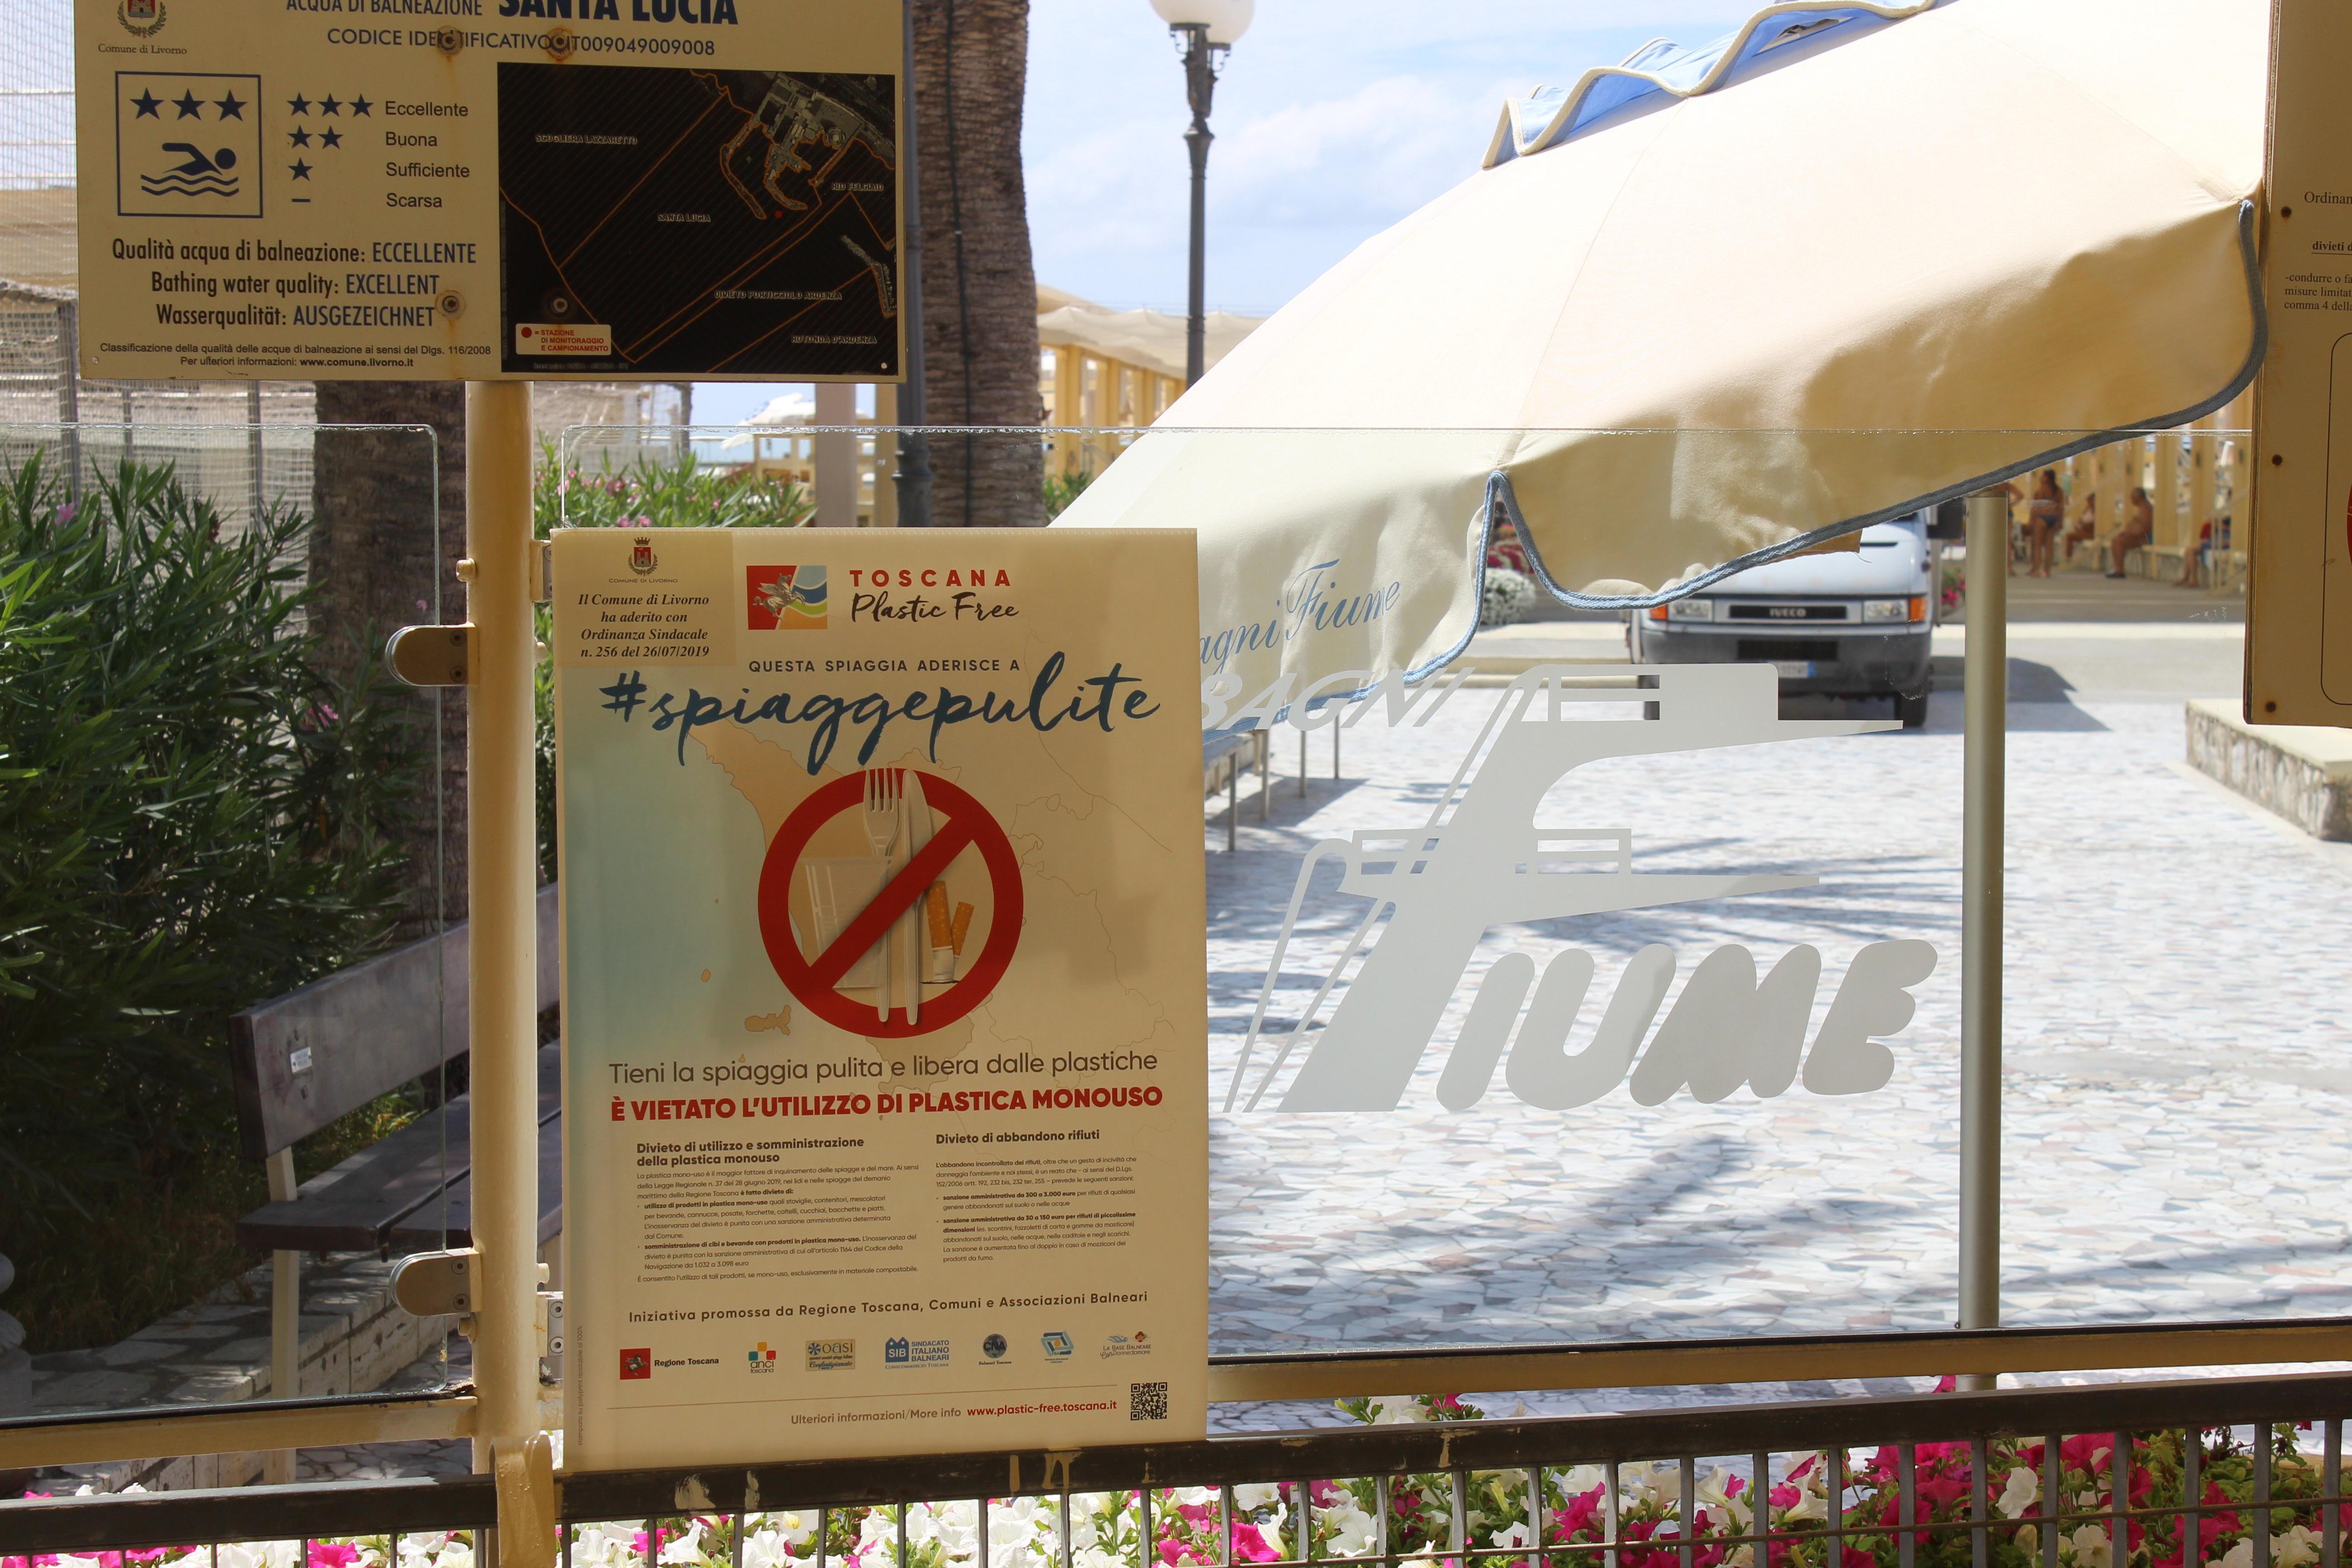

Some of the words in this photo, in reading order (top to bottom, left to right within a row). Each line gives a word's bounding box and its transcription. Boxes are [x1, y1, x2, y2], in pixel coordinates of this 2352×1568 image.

[328, 29, 402, 45] CODICE
[98, 44, 137, 53] Comune
[139, 45, 148, 53] di
[151, 45, 187, 54] Livorno
[386, 101, 468, 117] Eccellente
[386, 132, 437, 146] Buona
[386, 162, 470, 177] Sufficiente
[387, 193, 442, 207] Scarsa
[113, 238, 174, 260] Qualità
[181, 246, 229, 265] acqua
[236, 239, 250, 260] di
[258, 240, 365, 262] balneazione:
[373, 242, 476, 263] ECCELLENTE
[2313, 241, 2344, 251] divieti
[152, 271, 216, 297] Bathing
[223, 276, 270, 293] water
[276, 272, 338, 299] quality:
[347, 274, 439, 294] EXCELLENT
[2285, 273, 2332, 283] -condurre
[2285, 287, 2318, 296] misure
[2284, 302, 2319, 310] comma
[2323, 301, 2329, 310] 4
[157, 304, 286, 329] Wasserqualität:
[293, 305, 436, 327] AUSGEZEICHNET
[100, 343, 172, 352] Classificazione
[176, 344, 198, 352] della
[201, 344, 233, 354] qualità
[236, 344, 259, 353] delle
[262, 346, 290, 355] acque
[294, 345, 302, 353] di
[305, 345, 362, 353] balneazione
[365, 345, 373, 353] ai
[377, 346, 401, 354] sensi
[404, 346, 417, 354] del
[449, 346, 490, 354] 116/2008
[181, 357, 196, 365] Per
[200, 356, 234, 366] ulteriori
[238, 357, 296, 366] informazioni:
[850, 570, 1010, 587] TOSCANA
[578, 594, 588, 604] Il
[592, 594, 642, 605] Comune
[647, 594, 658, 604] di
[662, 594, 709, 604] Livorno
[852, 591, 946, 622] Plastic
[951, 592, 1019, 621] Free
[601, 612, 616, 622] ha
[620, 612, 662, 622] aderito
[1770, 608, 1806, 617] IVECO
[582, 629, 645, 640] Ordinanza
[649, 629, 707, 639] Sindacale
[596, 647, 617, 657] 256
[622, 646, 640, 657] del
[643, 646, 709, 657] 26/07/2019
[1200, 601, 1280, 692] agni
[749, 661, 814, 672] QUESTA
[826, 660, 907, 671] SPIAGGIA
[917, 660, 999, 671] ADERISCE
[1010, 660, 1019, 670] A
[600, 651, 1161, 775] #spiaggepulite
[609, 1063, 664, 1083] Tieni
[674, 1062, 693, 1082] la
[703, 1059, 807, 1086] spiaggia
[817, 1057, 883, 1083] pulita
[891, 1062, 905, 1076] e
[914, 1055, 978, 1075] libera
[987, 1053, 1044, 1073] dalle
[1053, 1051, 1157, 1077] plastiche
[612, 1096, 625, 1121] È
[631, 1098, 735, 1120] VIETATO
[743, 1094, 871, 1117] L'UTILIZZO
[877, 1093, 902, 1113] DI
[910, 1091, 1027, 1112] PLASTICA
[1033, 1087, 1162, 1109] MONOUSO
[936, 1134, 979, 1144] Divieto
[982, 1132, 993, 1142] di
[996, 1132, 1064, 1142] abbandono
[1068, 1129, 1099, 1140] rifiuti
[637, 1143, 681, 1153] Divieto
[685, 1142, 696, 1152] di
[699, 1141, 743, 1151] utilizzo
[757, 1137, 864, 1149] somministrazione
[637, 1156, 667, 1166] della
[671, 1154, 720, 1167] plastica
[725, 1155, 779, 1163] monouso
[630, 1310, 695, 1322] Iniziativa
[702, 1309, 769, 1322] promossa
[776, 1306, 793, 1316] da
[800, 1304, 856, 1317] Regione
[862, 1303, 923, 1312] Toscana,
[929, 1298, 980, 1309] Comuni
[1000, 1294, 1084, 1307] Associazioni
[1091, 1291, 1147, 1303] Balneari
[888, 1348, 906, 1357] SIB
[983, 1341, 1007, 1352] CNA
[792, 1413, 834, 1424] Ulteriori
[838, 1409, 937, 1422] informazioni/More
[941, 1408, 961, 1417] info
[967, 1401, 1117, 1416] www.plastic-free.toscana.it
